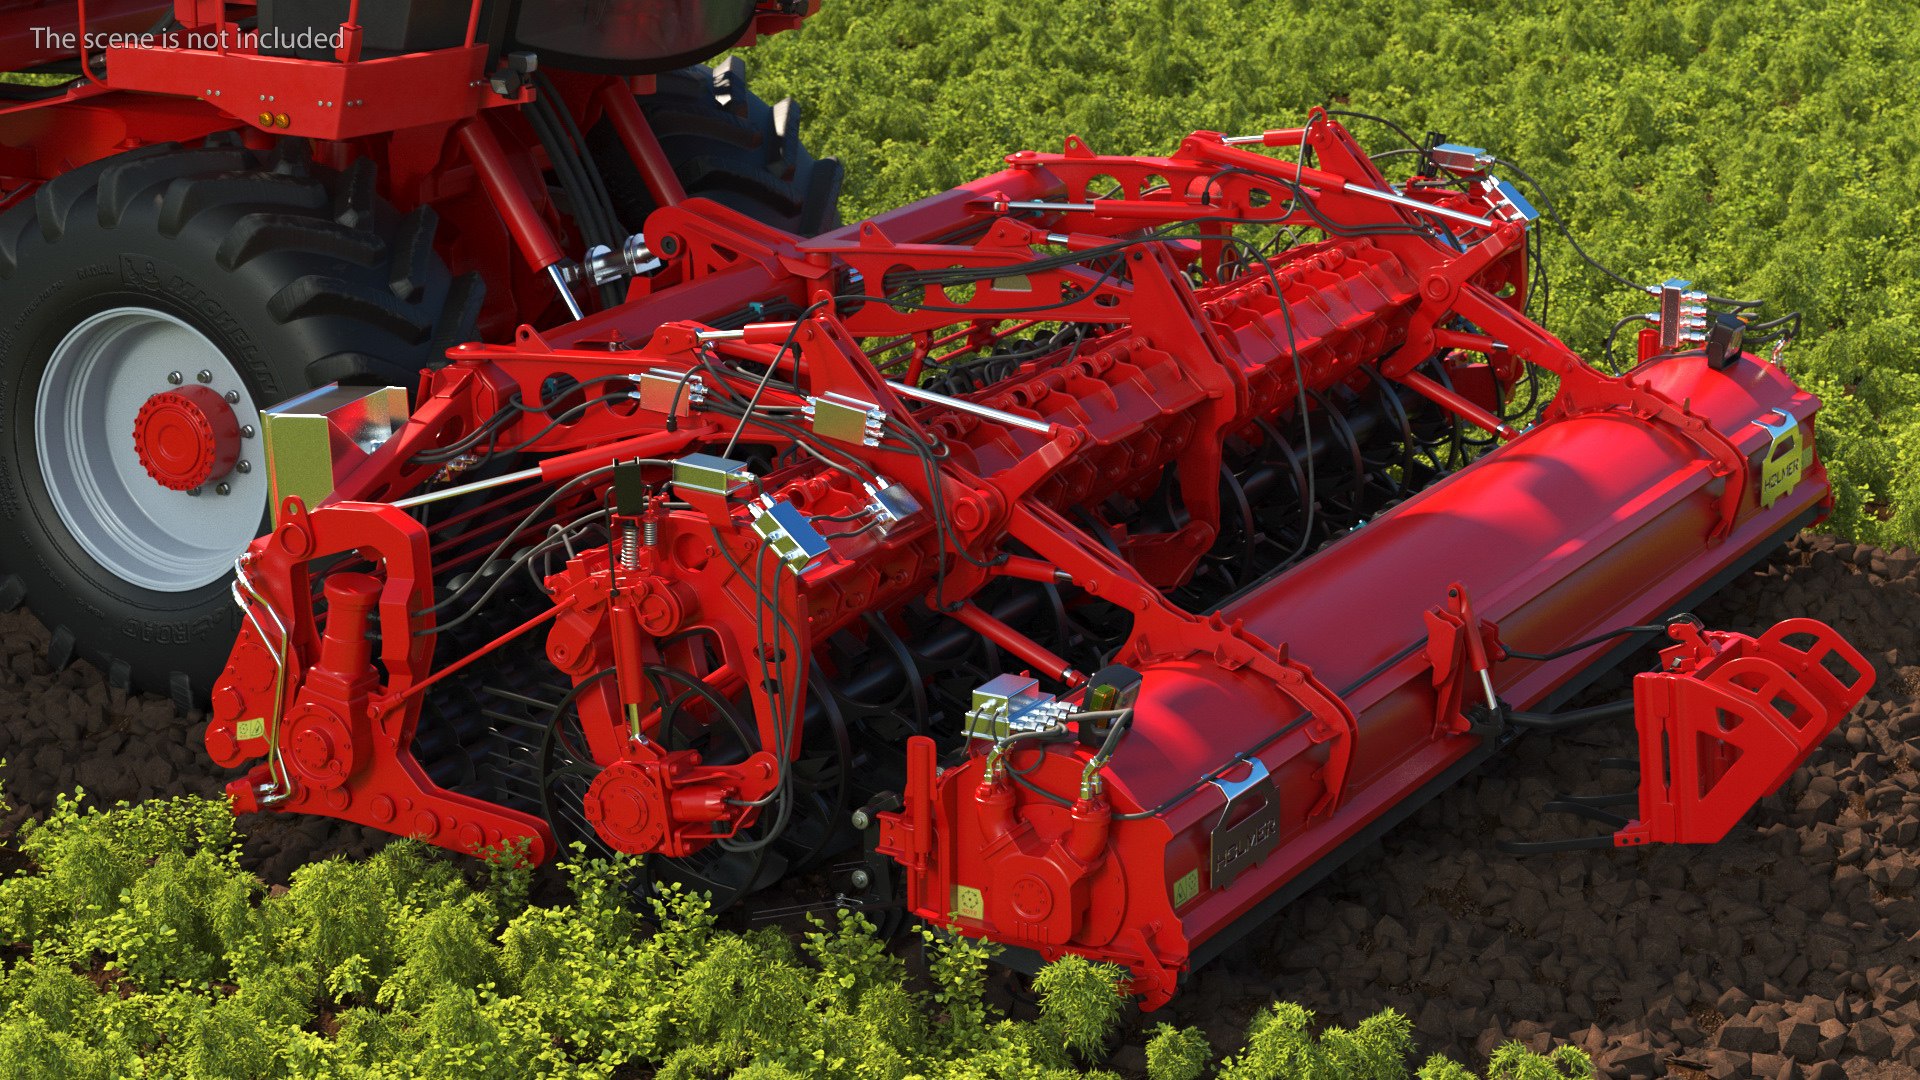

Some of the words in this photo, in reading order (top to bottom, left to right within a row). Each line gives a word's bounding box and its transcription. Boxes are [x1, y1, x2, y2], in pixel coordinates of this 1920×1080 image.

[167, 274, 280, 396] MICHELIN
[1764, 458, 1799, 491] HOLMER
[1216, 818, 1276, 873] HOLMER
